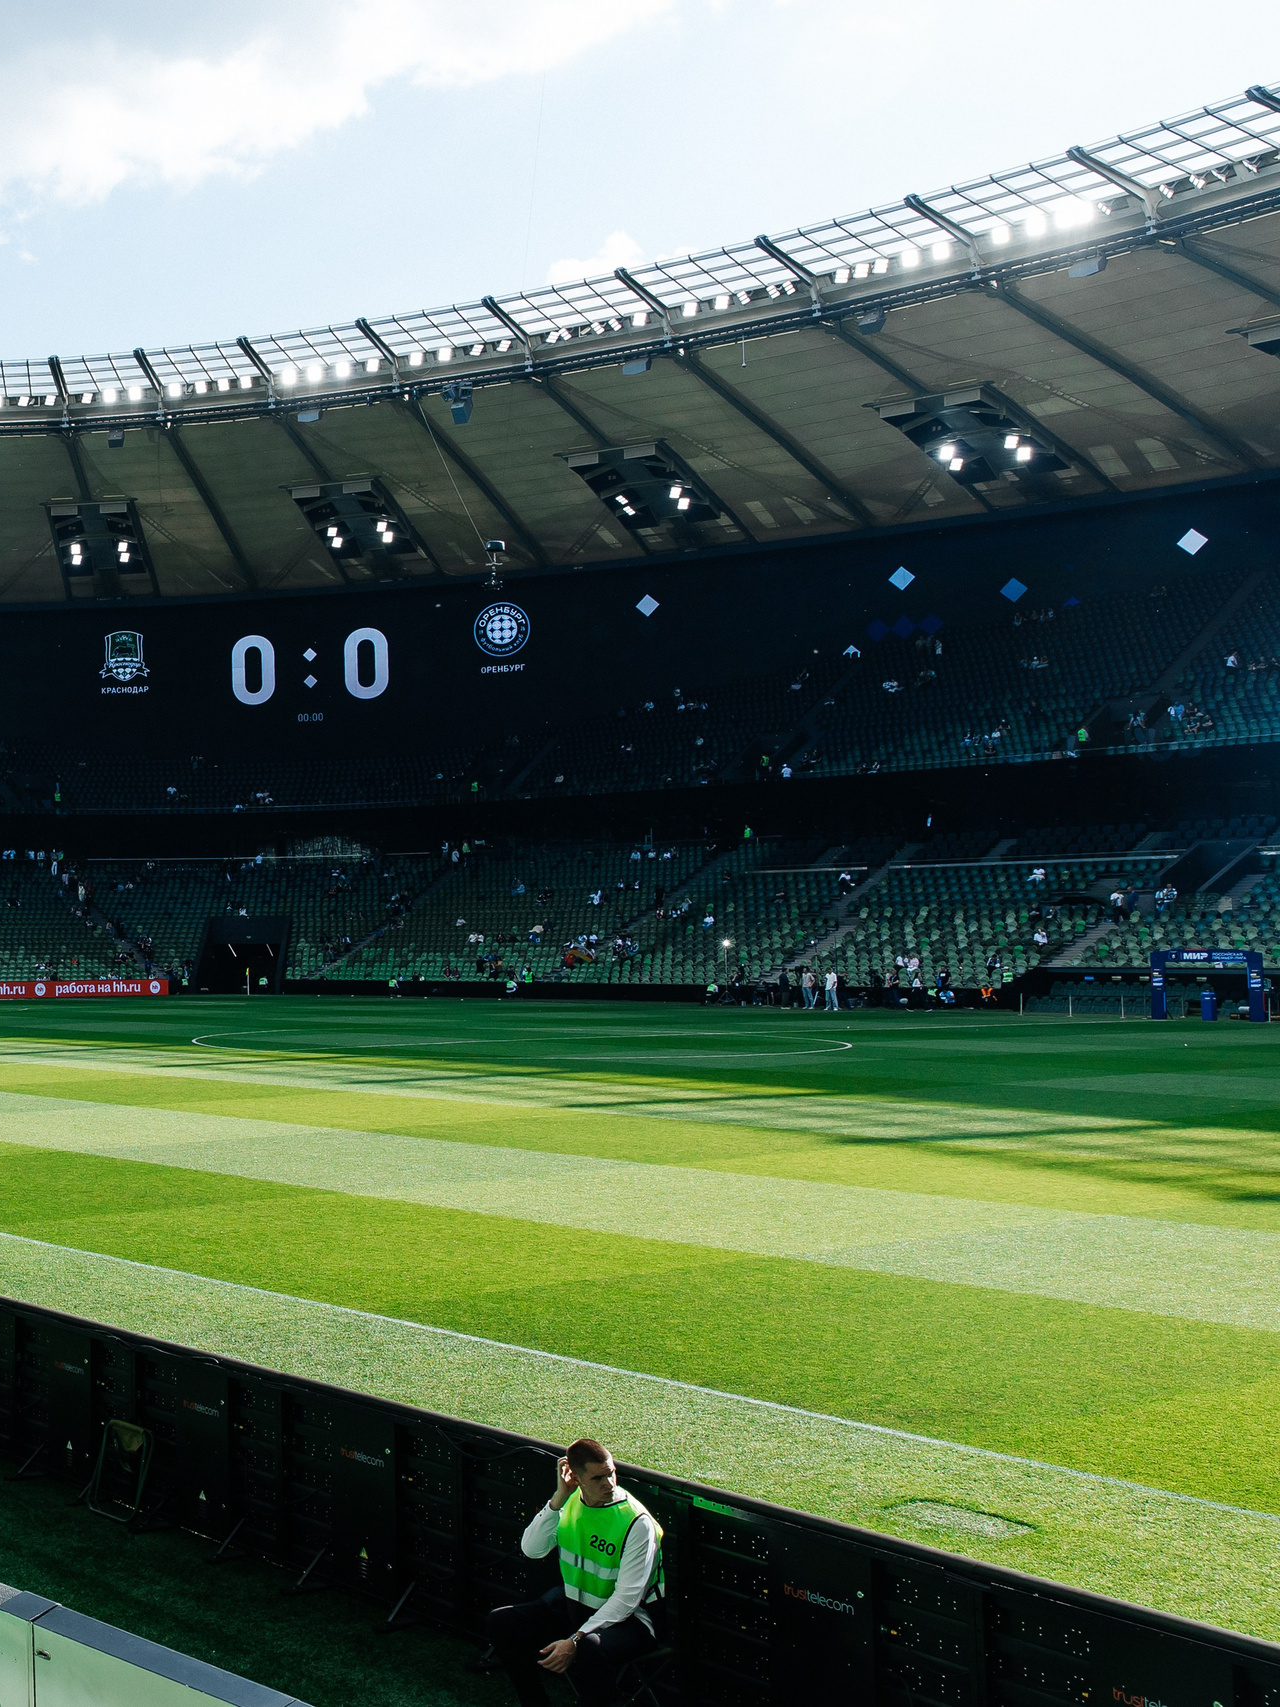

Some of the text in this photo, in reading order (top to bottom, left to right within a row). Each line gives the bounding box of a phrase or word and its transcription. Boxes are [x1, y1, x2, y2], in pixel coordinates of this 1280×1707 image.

[480, 663, 526, 674] ОРЕНБУРГ
[101, 685, 150, 695] КРАСНОДАР
[297, 712, 324, 722] 00:00
[1183, 952, 1209, 960] МИР
[55, 981, 141, 996] работа на hh.ru
[589, 1534, 616, 1557] 280
[783, 1582, 855, 1616] trusttelecom
